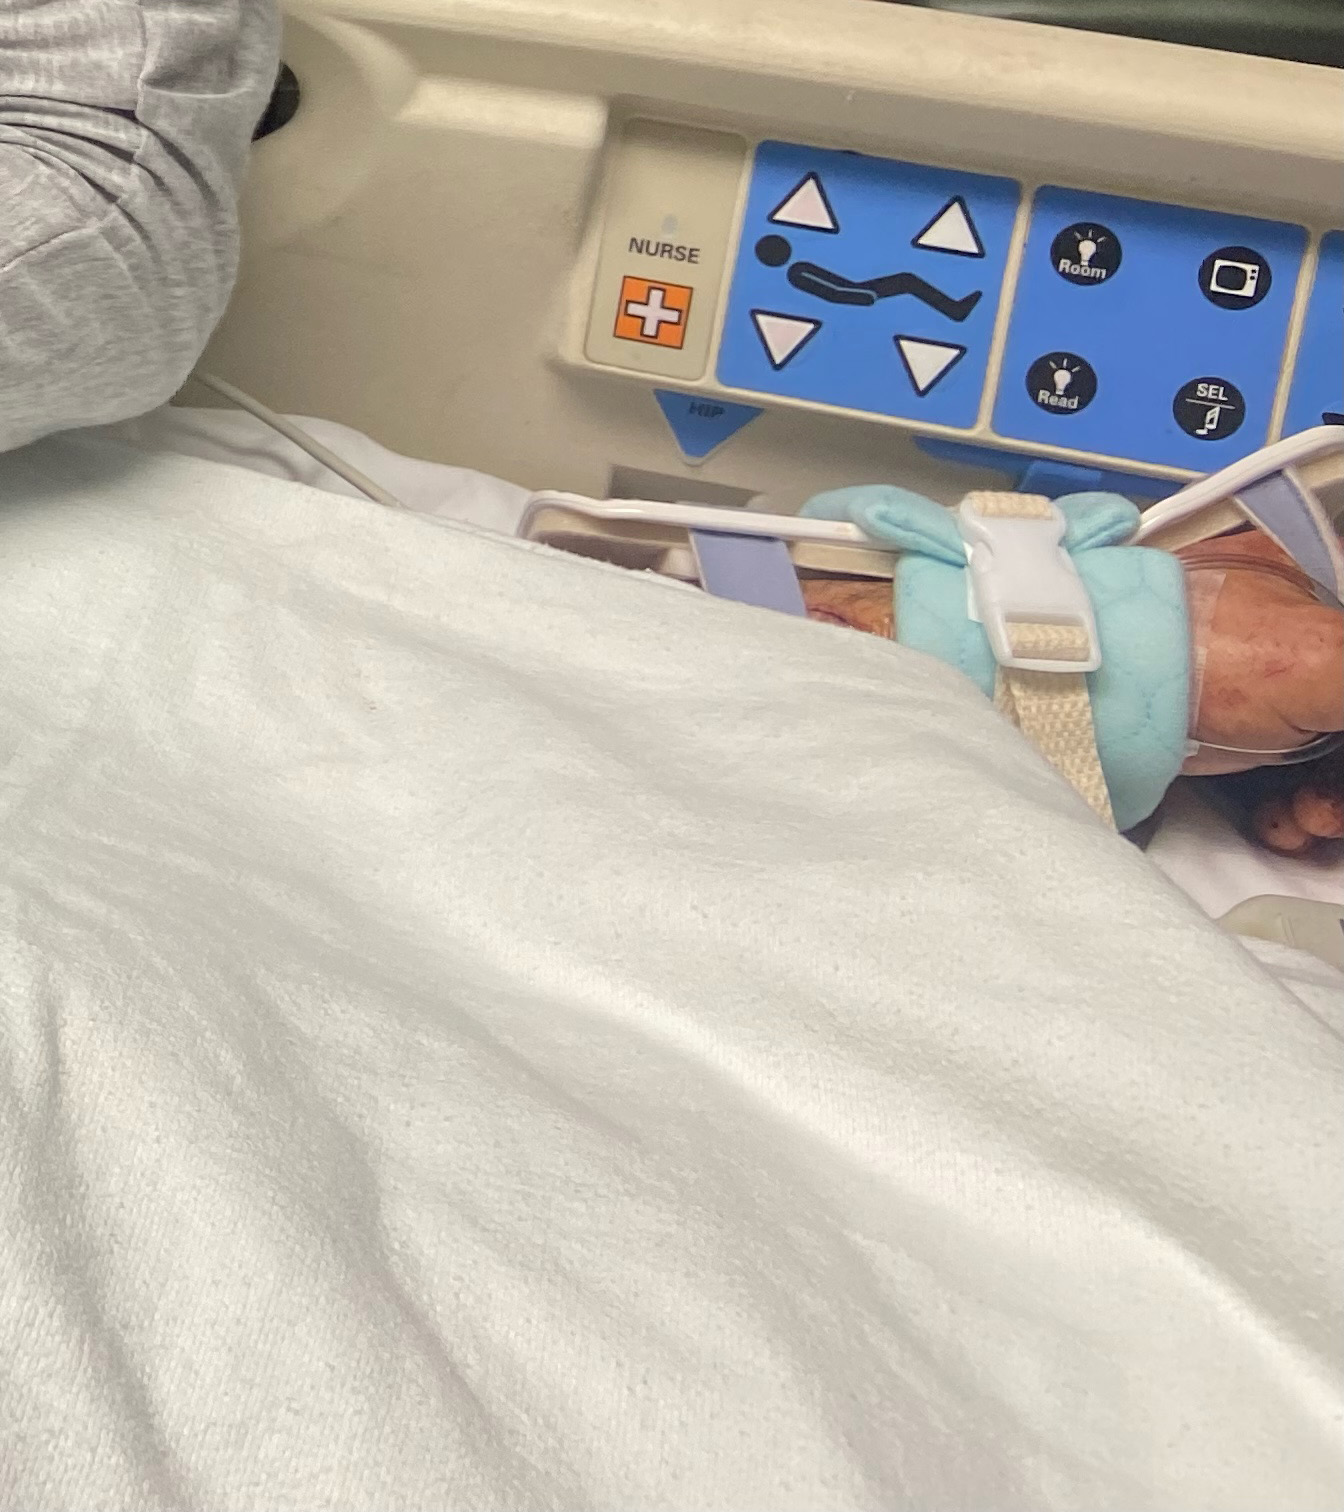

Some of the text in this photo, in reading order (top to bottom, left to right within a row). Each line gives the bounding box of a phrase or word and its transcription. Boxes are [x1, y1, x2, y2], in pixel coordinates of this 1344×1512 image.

[628, 237, 701, 265] NURSE
[1058, 257, 1107, 280] Room
[1037, 389, 1079, 410] Read
[1196, 382, 1228, 401] SEL
